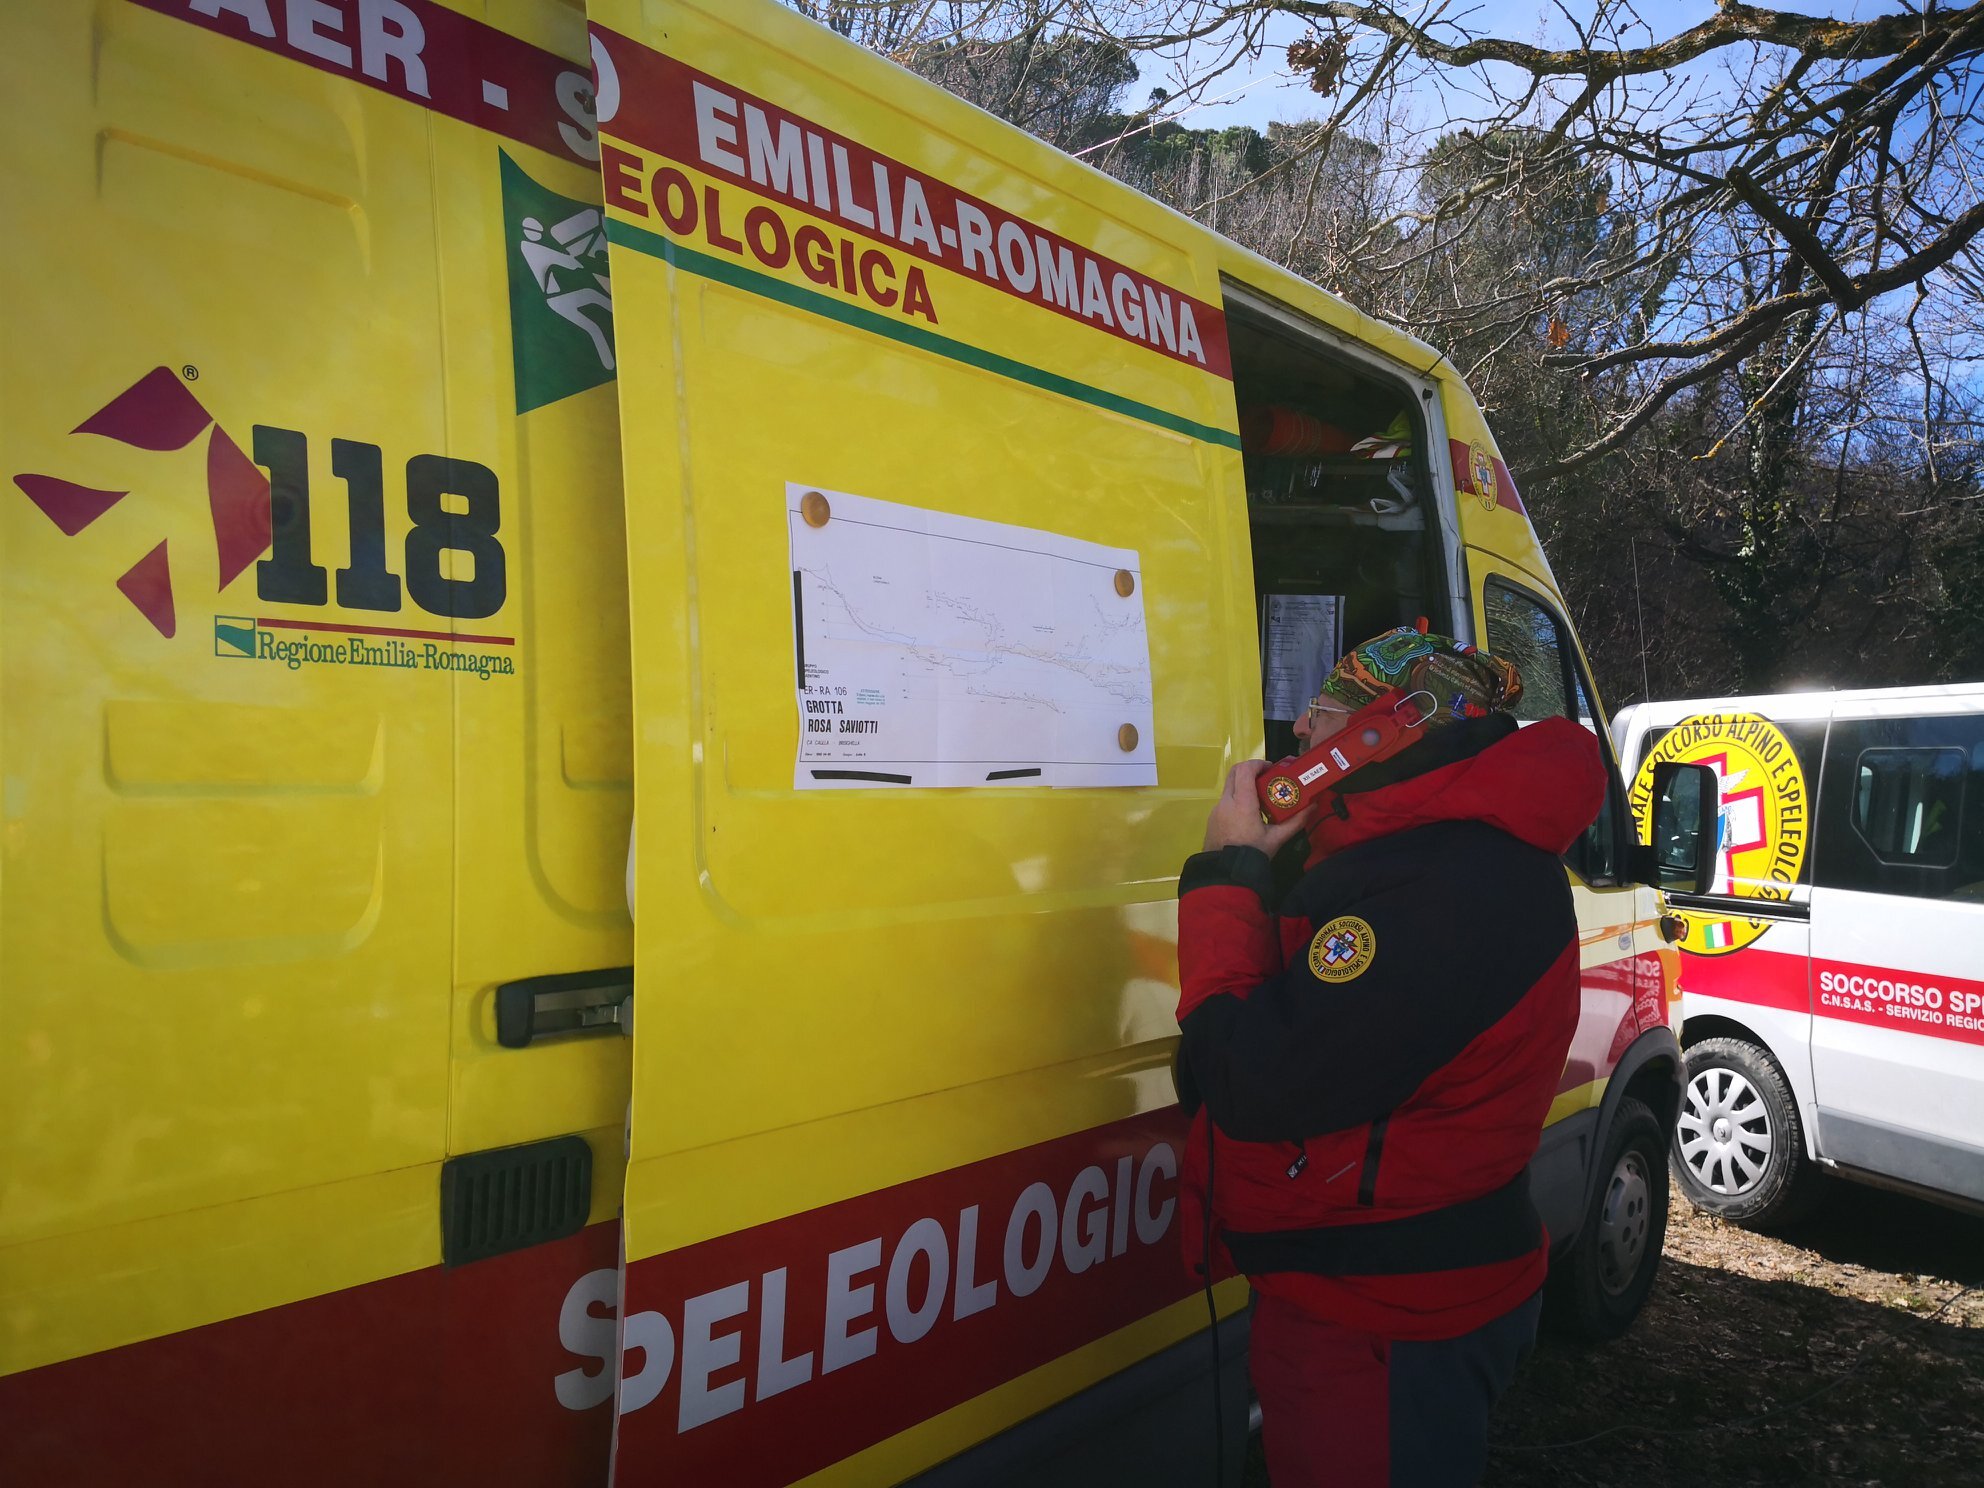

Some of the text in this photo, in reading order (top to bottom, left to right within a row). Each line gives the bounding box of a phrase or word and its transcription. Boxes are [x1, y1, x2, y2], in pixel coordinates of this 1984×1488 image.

[601, 143, 939, 324] EOLOGICA
[693, 81, 1207, 365] EMILIA-ROMAGNA
[252, 424, 507, 619] 118
[806, 700, 844, 714] GROTTA
[834, 686, 847, 696] 106
[808, 718, 878, 734] ROSA SAVIOTTI
[1647, 714, 1722, 773] SOCCORSO
[1725, 714, 1782, 763] ALPINO
[1771, 758, 1793, 779] E
[1820, 971, 1942, 1009] SOCCORSO
[1821, 993, 1875, 1013] C.N.S.A.S.
[1886, 1003, 1943, 1025] SERVIZIO
